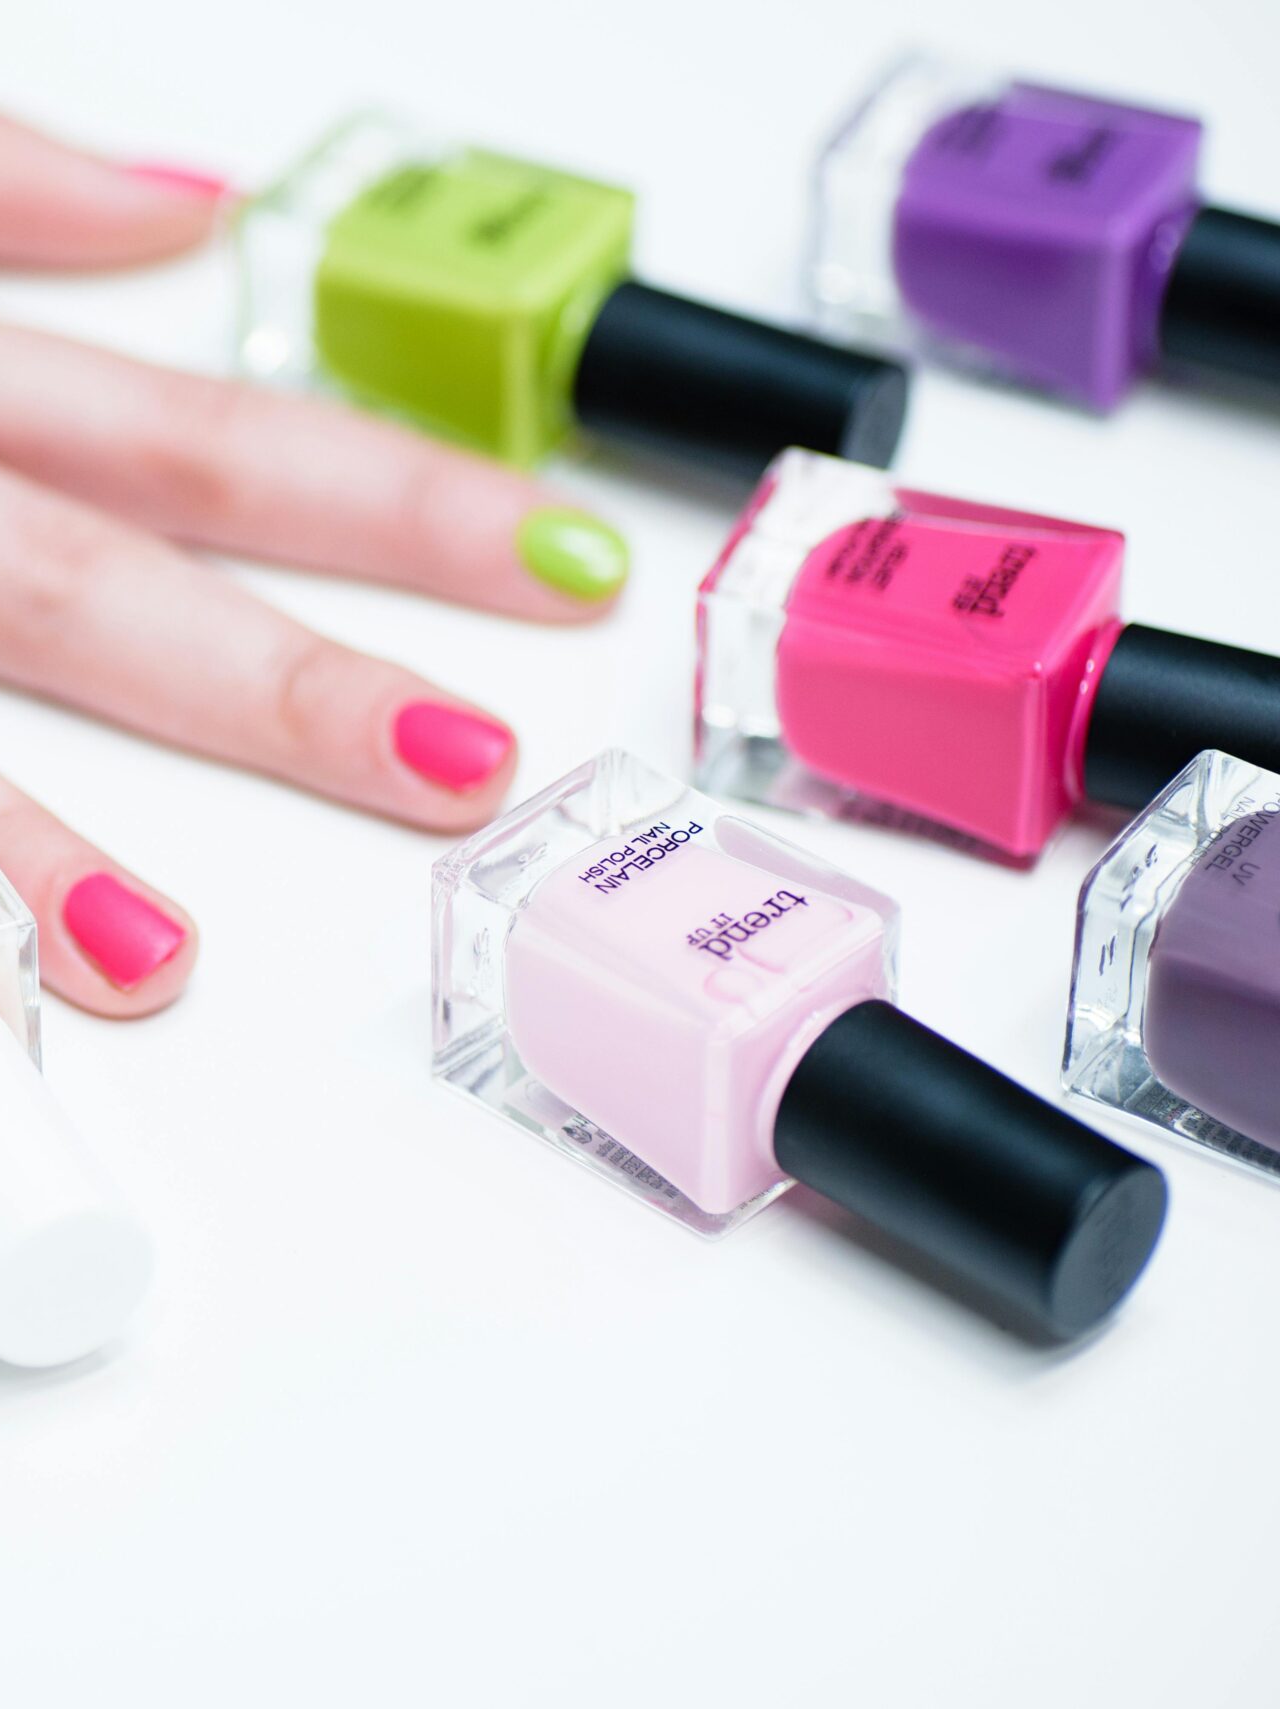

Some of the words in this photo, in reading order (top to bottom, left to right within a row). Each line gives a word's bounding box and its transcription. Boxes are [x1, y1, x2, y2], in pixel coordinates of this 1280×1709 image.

[631, 821, 671, 845] NAIL
[578, 845, 636, 883] POLISH
[594, 820, 704, 894] PORCELAIN
[1232, 862, 1261, 886] UV
[698, 890, 810, 961] trend
[711, 912, 735, 928] IT
[686, 927, 714, 946] UP
